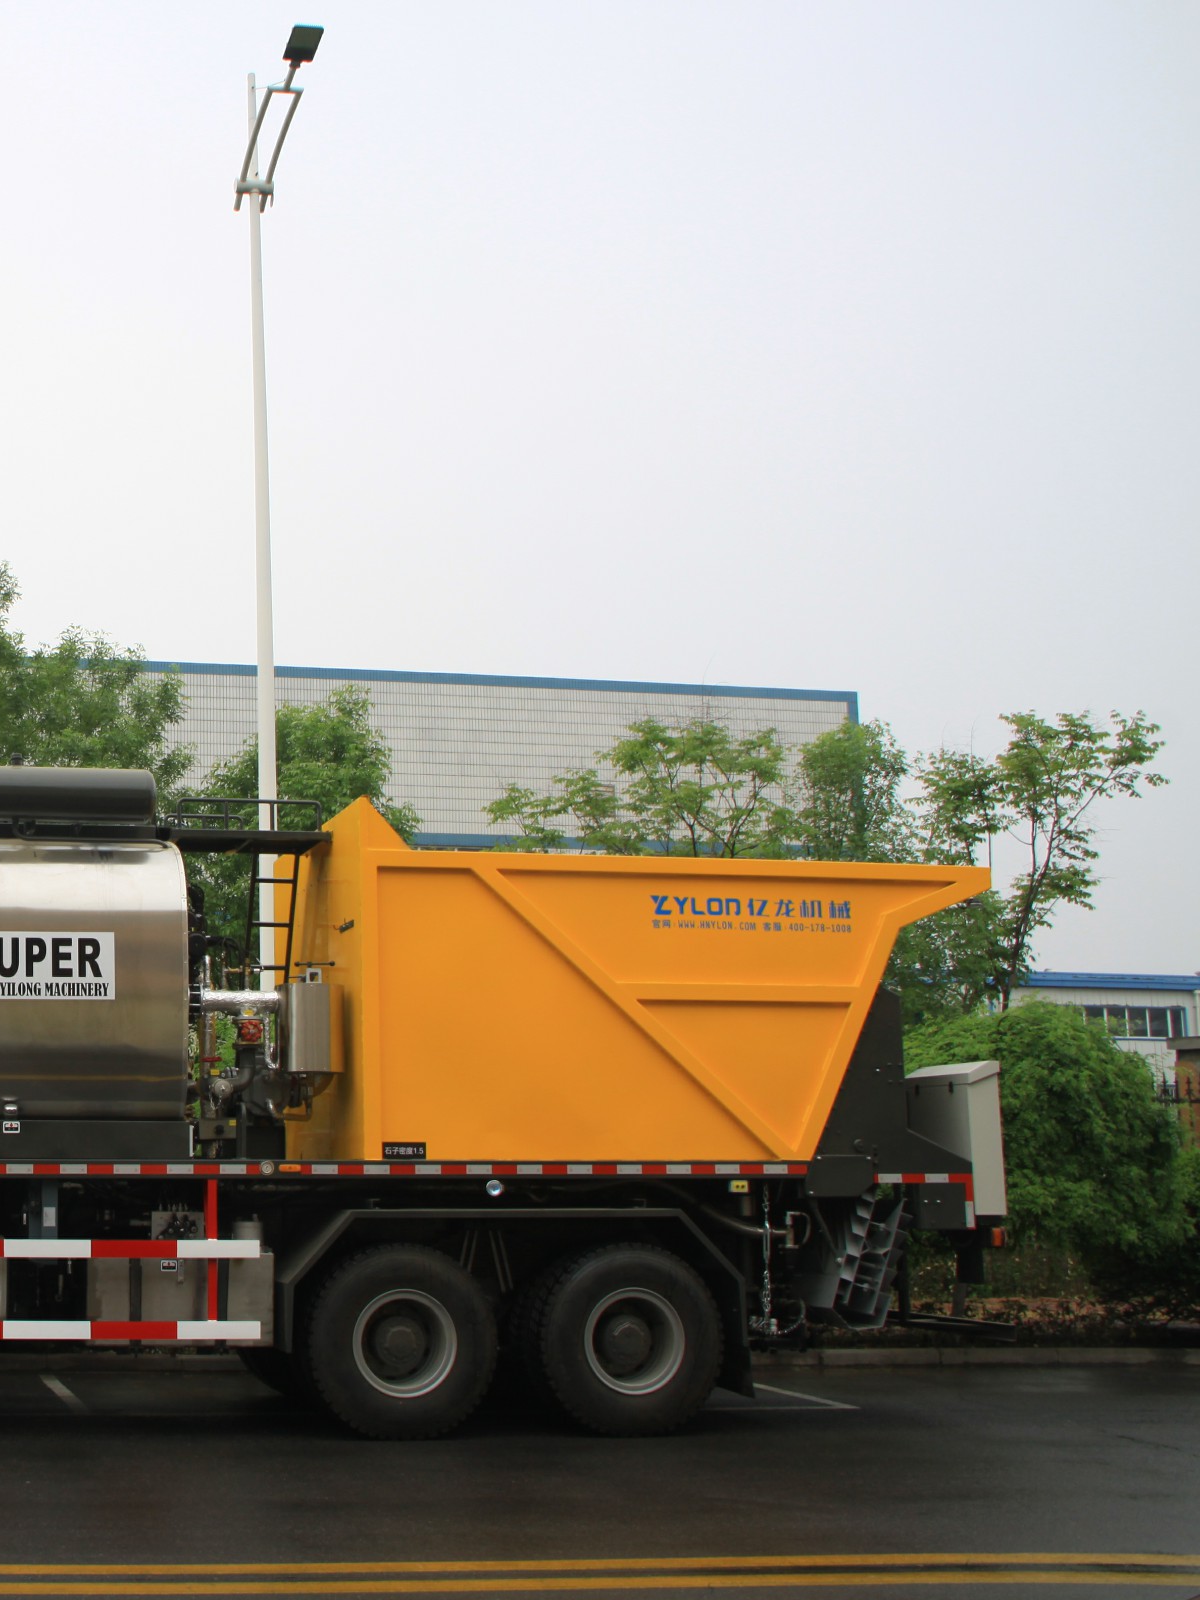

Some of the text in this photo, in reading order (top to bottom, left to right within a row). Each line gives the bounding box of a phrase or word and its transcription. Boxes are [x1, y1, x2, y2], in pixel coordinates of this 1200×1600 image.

[747, 898, 851, 918] 亿龙机械
[0, 981, 109, 997] YILONG MACHINERY
